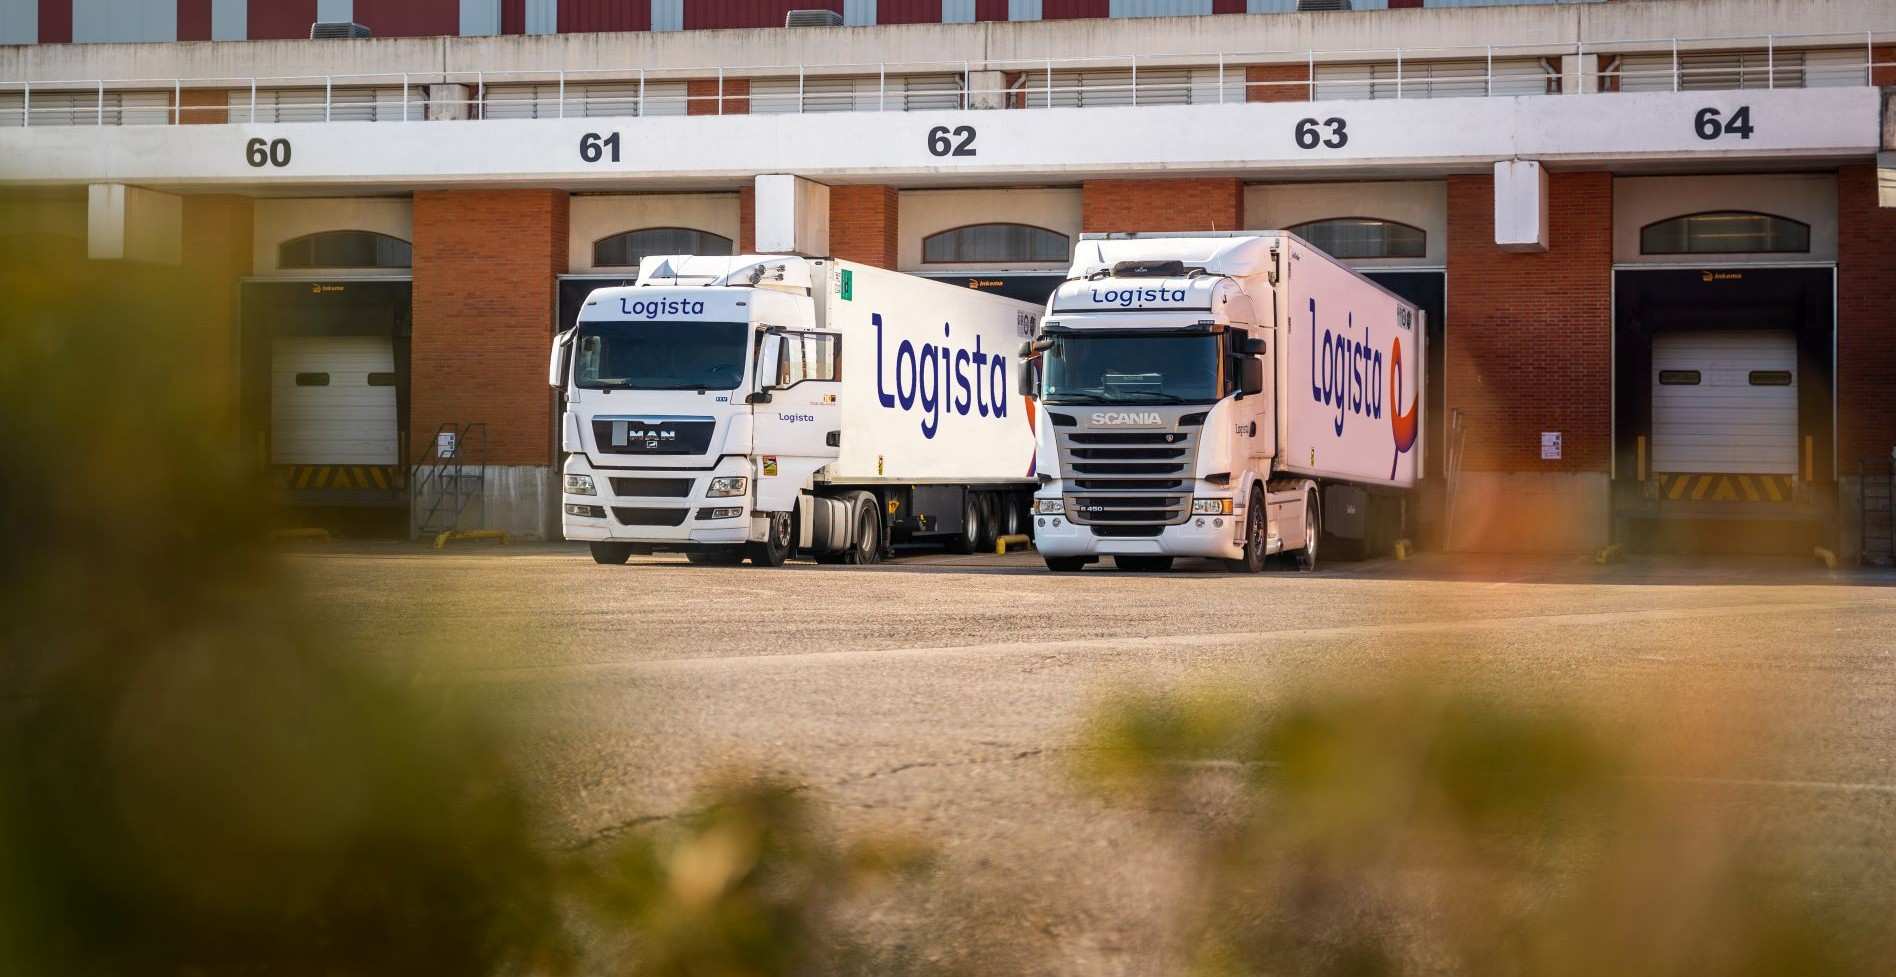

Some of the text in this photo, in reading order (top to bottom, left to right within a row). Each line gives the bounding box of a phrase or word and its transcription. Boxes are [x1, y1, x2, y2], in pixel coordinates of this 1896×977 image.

[1295, 117, 1349, 150] 63
[1694, 105, 1755, 141] 64
[246, 137, 291, 167] 60
[580, 132, 621, 163] 61
[928, 125, 977, 156] 62
[1091, 412, 1162, 425] SCANIA
[629, 430, 676, 441] MAN
